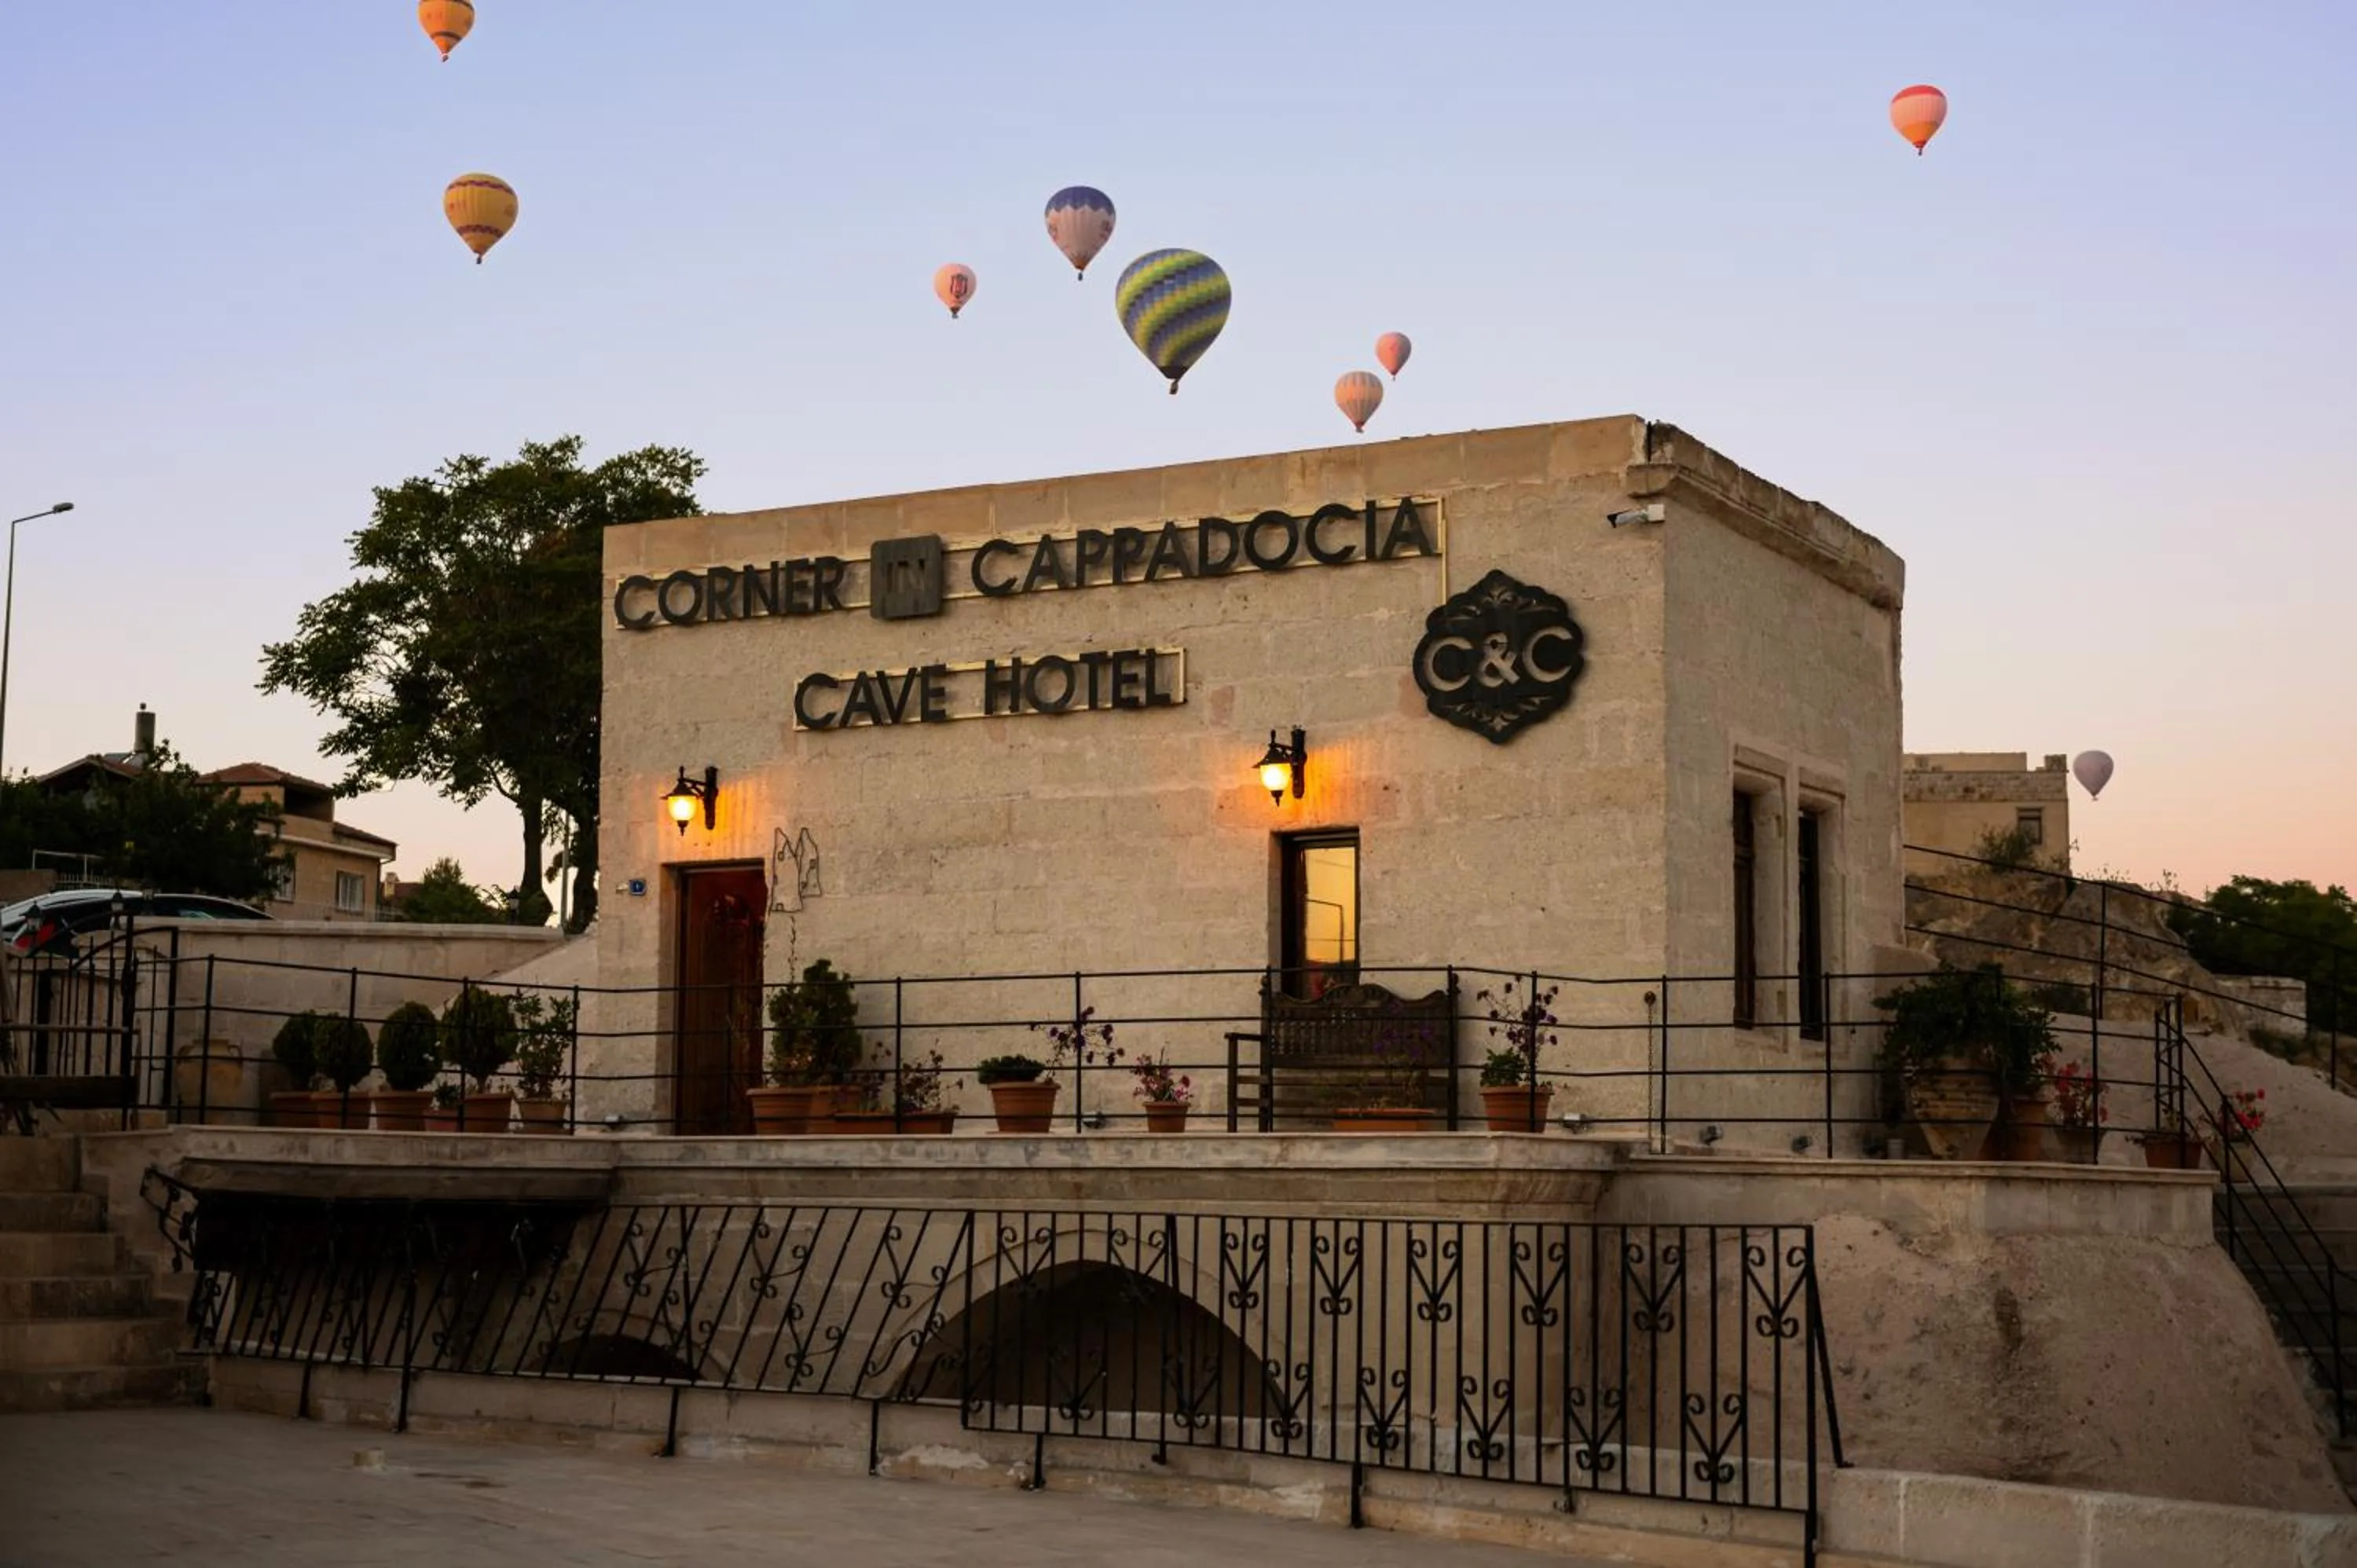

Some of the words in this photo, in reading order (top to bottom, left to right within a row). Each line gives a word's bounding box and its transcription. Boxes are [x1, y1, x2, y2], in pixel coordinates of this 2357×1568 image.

[614, 555, 845, 626] CORNER
[886, 558, 926, 595] IN
[971, 496, 1435, 596] CAPPADOCIA
[794, 664, 947, 730] CAVE
[984, 647, 1171, 715] HOTEL
[1424, 625, 1574, 692] C&C
